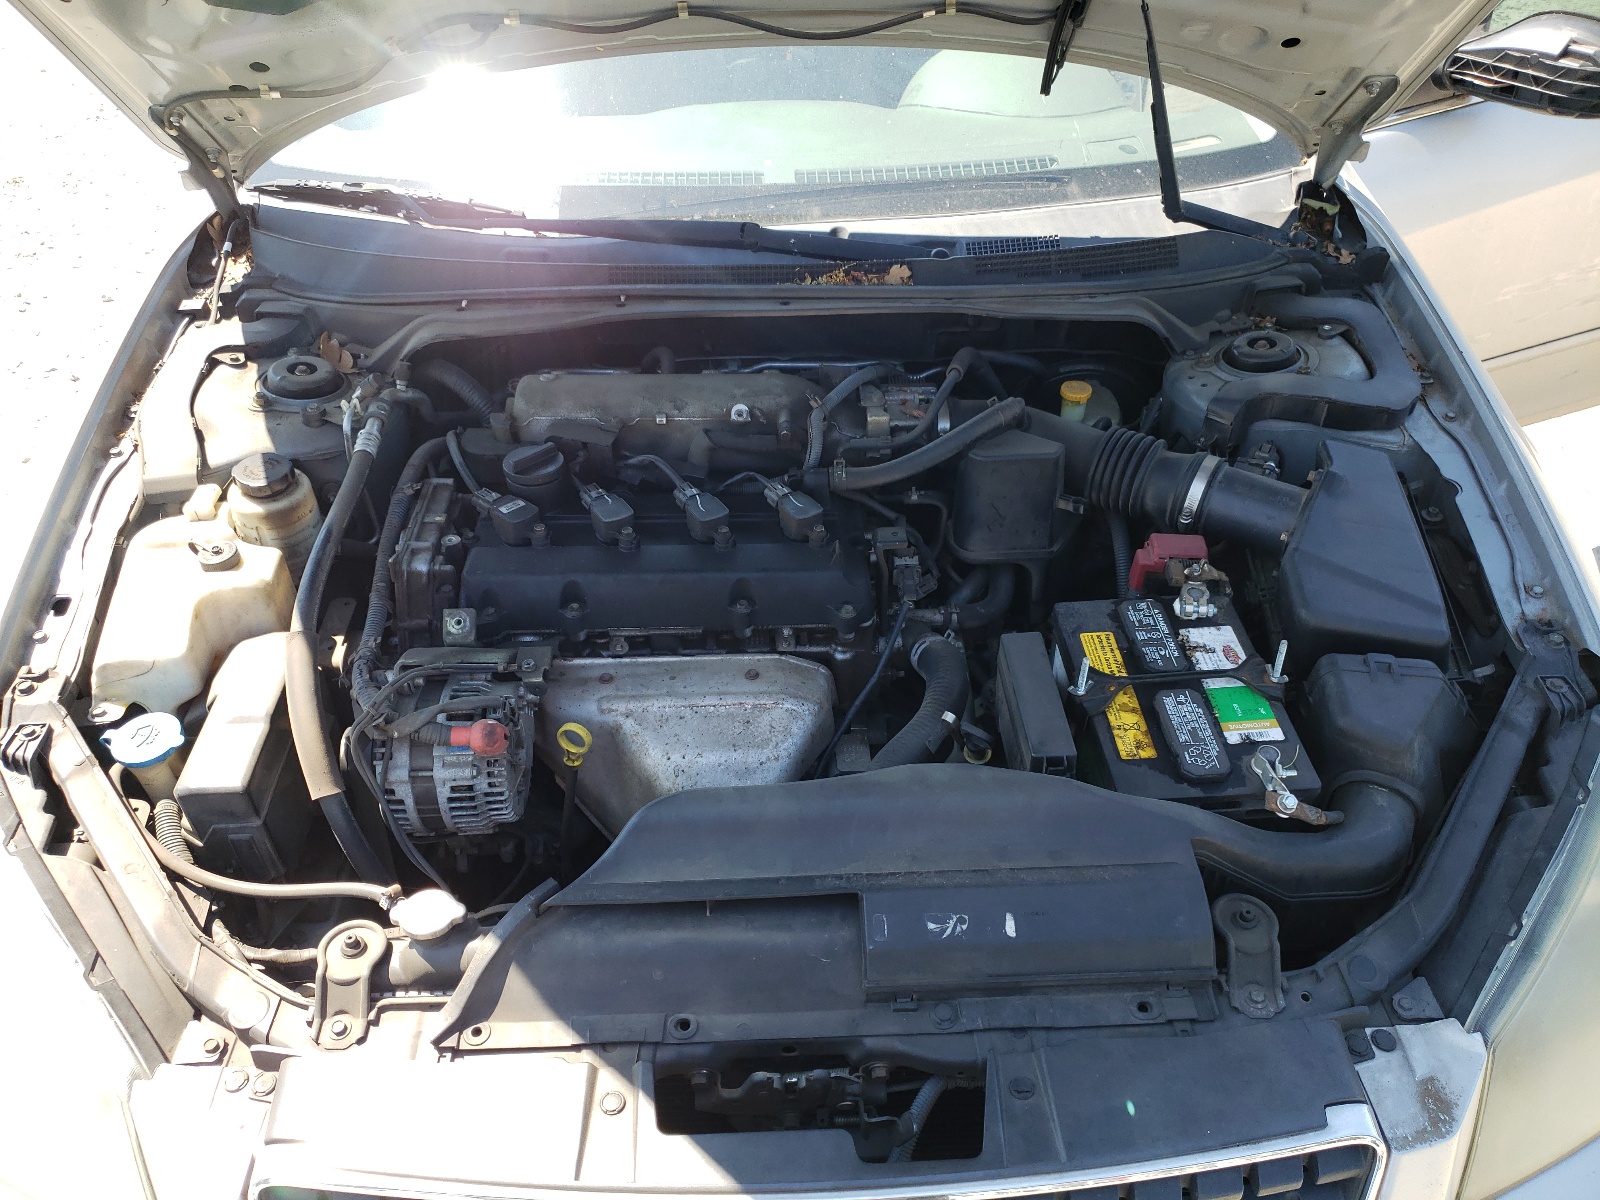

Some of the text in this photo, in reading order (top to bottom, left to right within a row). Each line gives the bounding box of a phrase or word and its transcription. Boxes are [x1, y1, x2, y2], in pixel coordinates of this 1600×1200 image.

[1155, 613, 1169, 634] DANGER
[1165, 638, 1180, 657] POISON
[1227, 721, 1270, 730] AUTOMOTIVE
